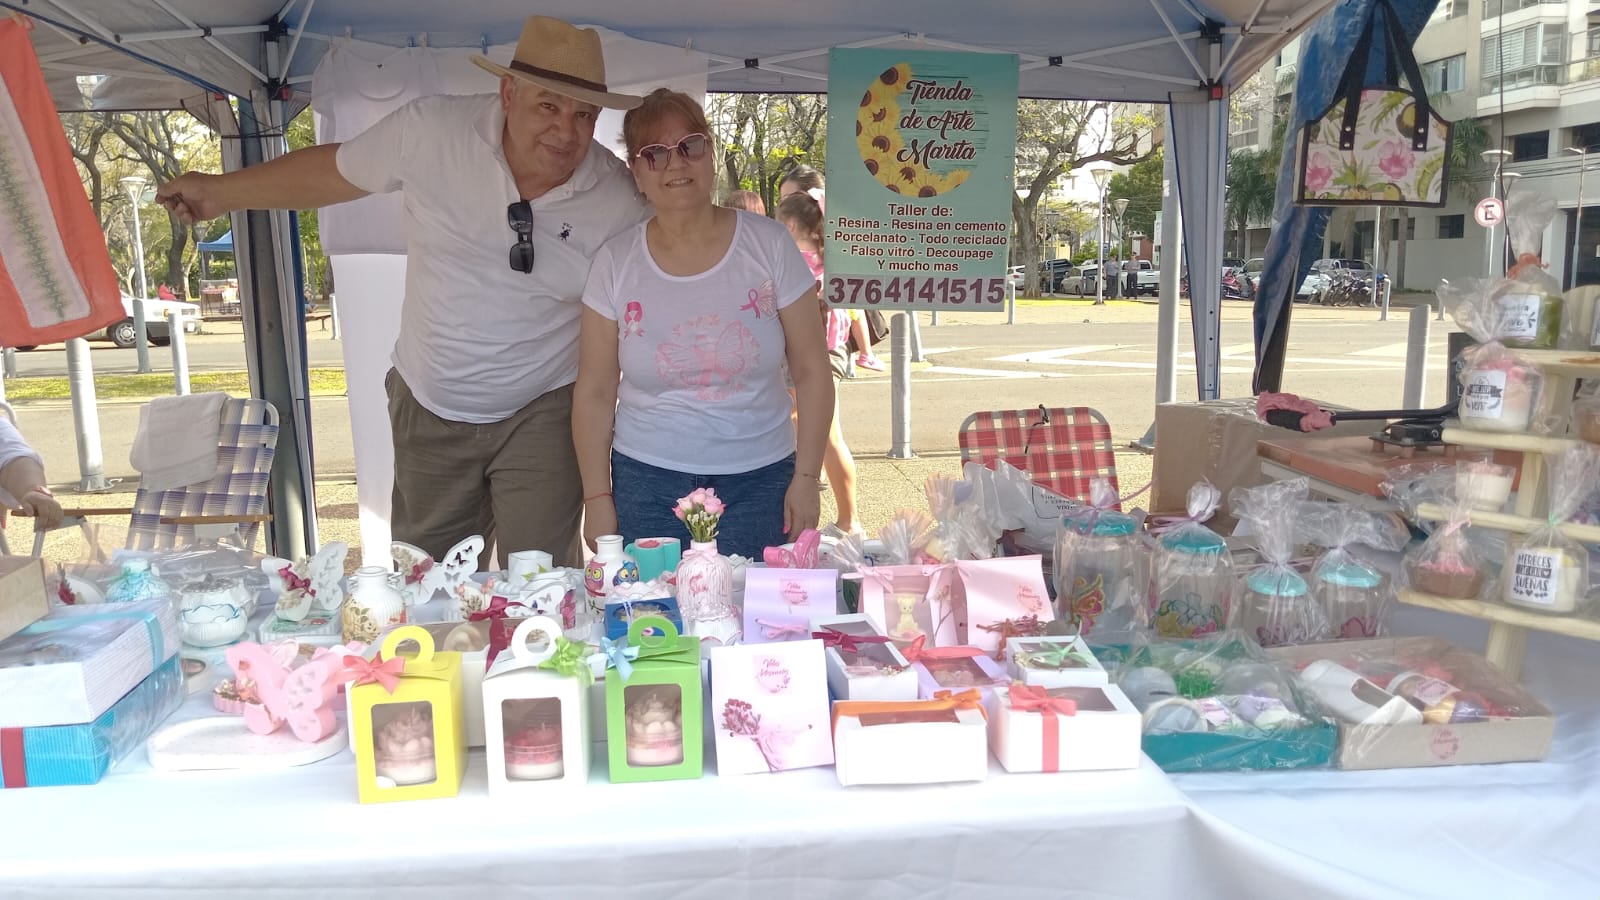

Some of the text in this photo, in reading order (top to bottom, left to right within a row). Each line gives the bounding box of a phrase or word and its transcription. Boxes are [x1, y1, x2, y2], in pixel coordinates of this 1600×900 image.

[906, 80, 973, 105] Tienda
[900, 108, 976, 140] de Arte
[896, 138, 977, 170] Marita
[888, 203, 953, 217] Taller de:
[838, 217, 880, 229] Resina
[891, 219, 933, 231] Resina
[937, 222, 951, 231] en
[955, 221, 1006, 232] cemento
[834, 231, 907, 244] Porcelanato
[918, 233, 949, 245] Todo
[953, 234, 1007, 245] reciclado
[851, 245, 884, 257] Falso
[887, 246, 915, 258] vitró
[926, 247, 994, 261] Decoupage
[877, 260, 959, 272] Y mucho mas
[828, 276, 1006, 305] 3764141515
